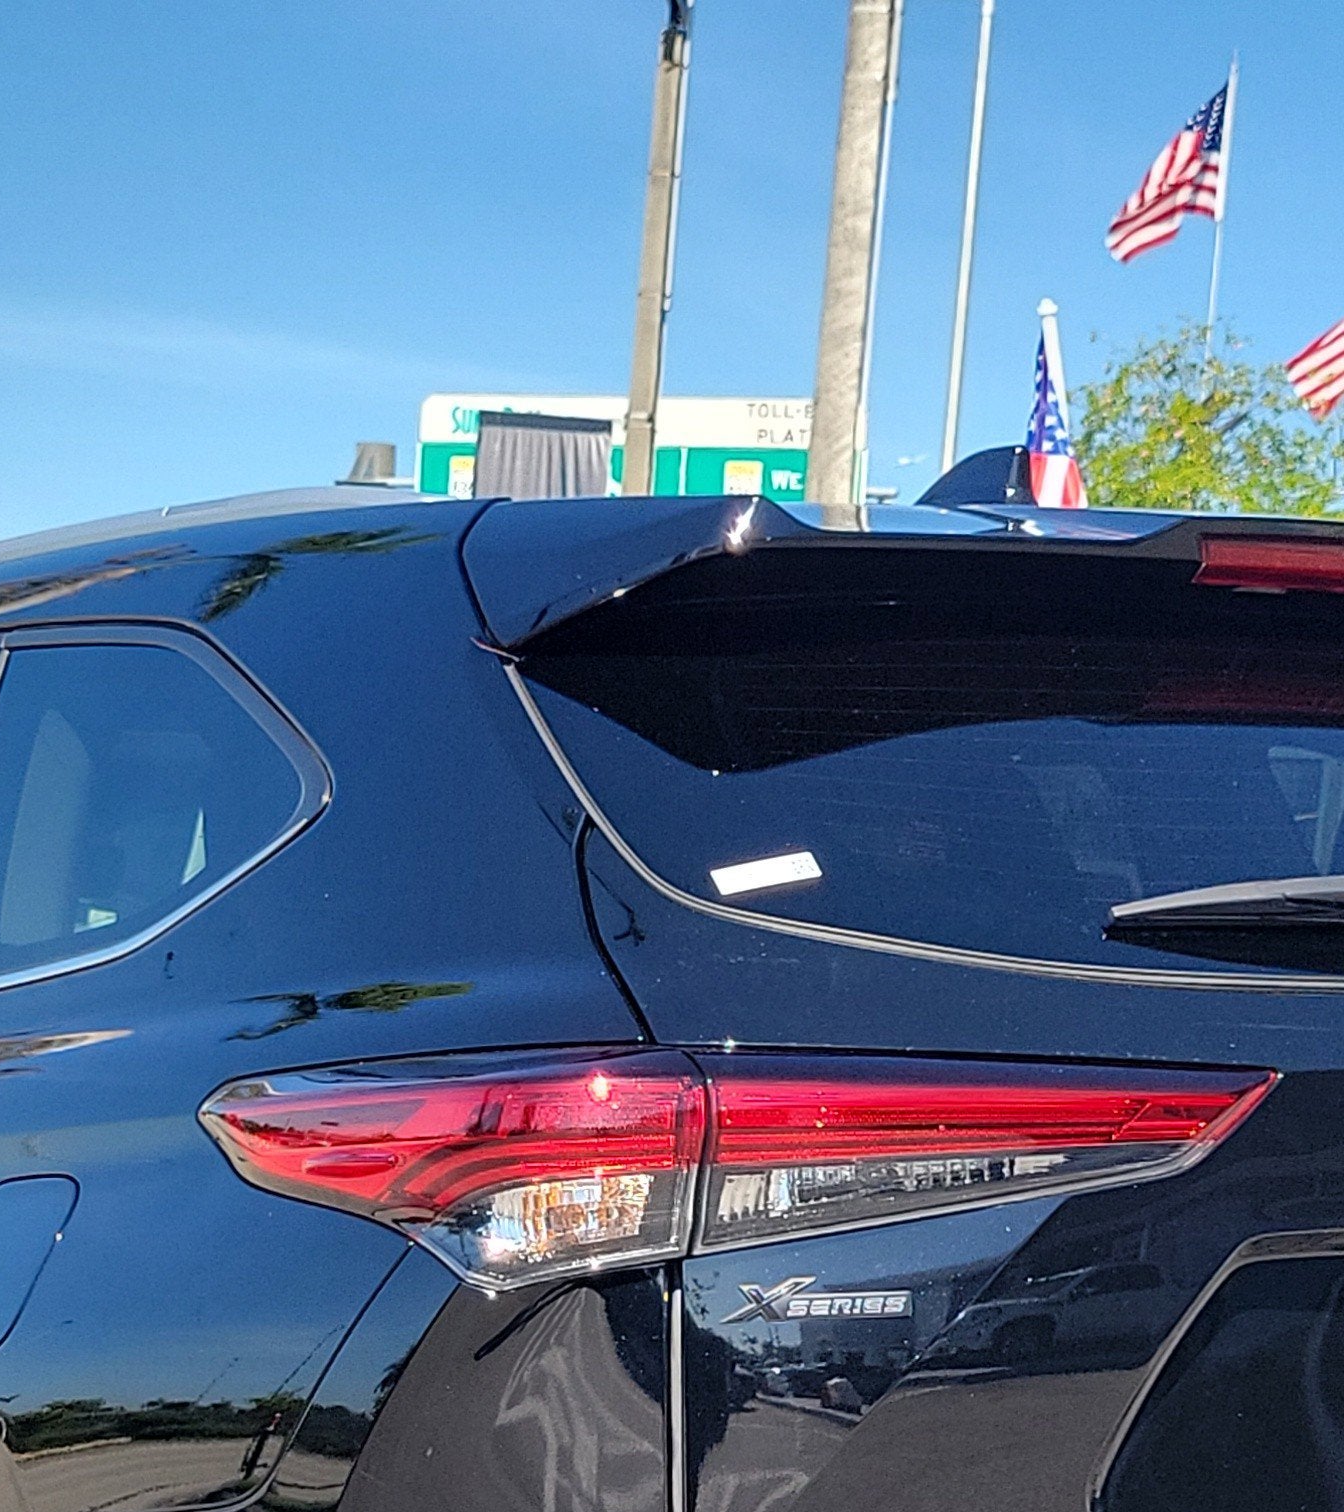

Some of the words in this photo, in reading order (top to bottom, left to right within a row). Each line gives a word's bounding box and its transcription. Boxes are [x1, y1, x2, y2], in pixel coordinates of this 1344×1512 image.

[747, 402, 816, 420] TOLL-B
[757, 428, 811, 445] PLAT
[770, 469, 805, 491] WE
